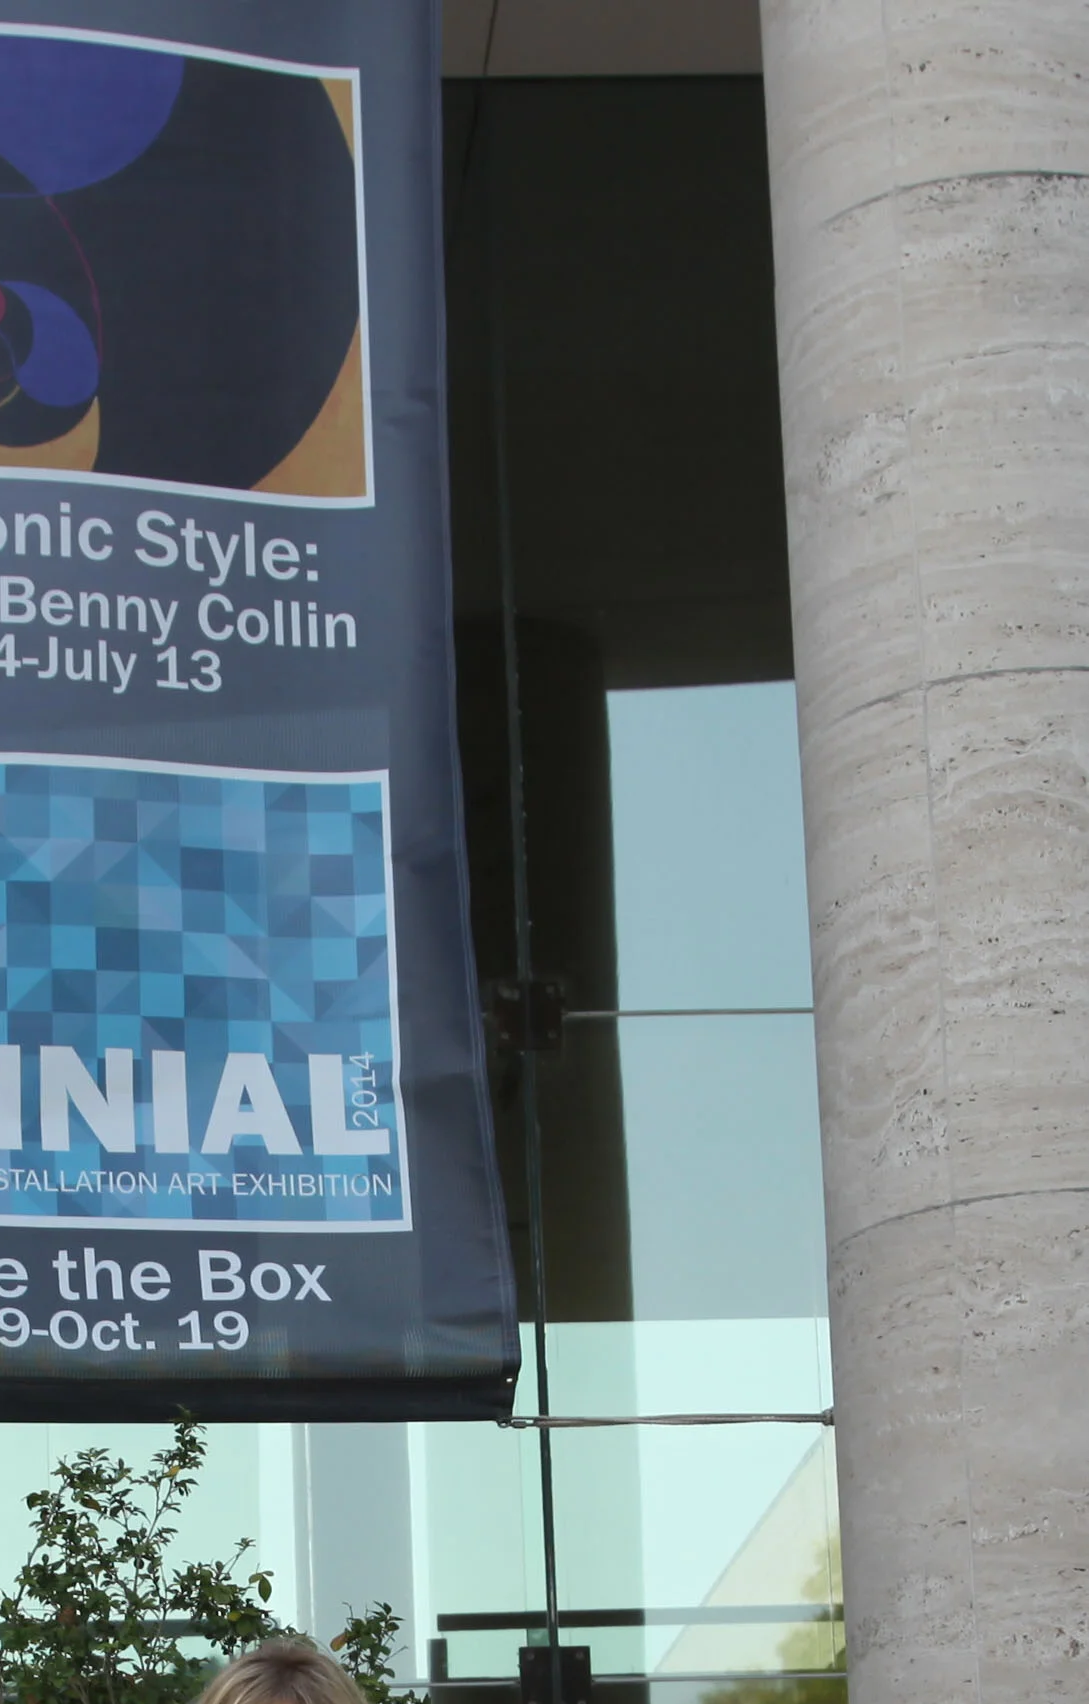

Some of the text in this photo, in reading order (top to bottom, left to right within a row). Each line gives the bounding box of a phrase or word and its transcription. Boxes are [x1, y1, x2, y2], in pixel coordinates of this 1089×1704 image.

[134, 509, 319, 587] Style:
[0, 575, 179, 645] Benny
[197, 592, 357, 648] Collin
[155, 645, 223, 692] 13
[348, 1050, 380, 1128] 2014
[167, 1172, 222, 1195] ART
[231, 1173, 393, 1197] EXHIBITION
[52, 1247, 172, 1301] the
[198, 1249, 333, 1302] Box
[177, 1310, 250, 1351] 19
